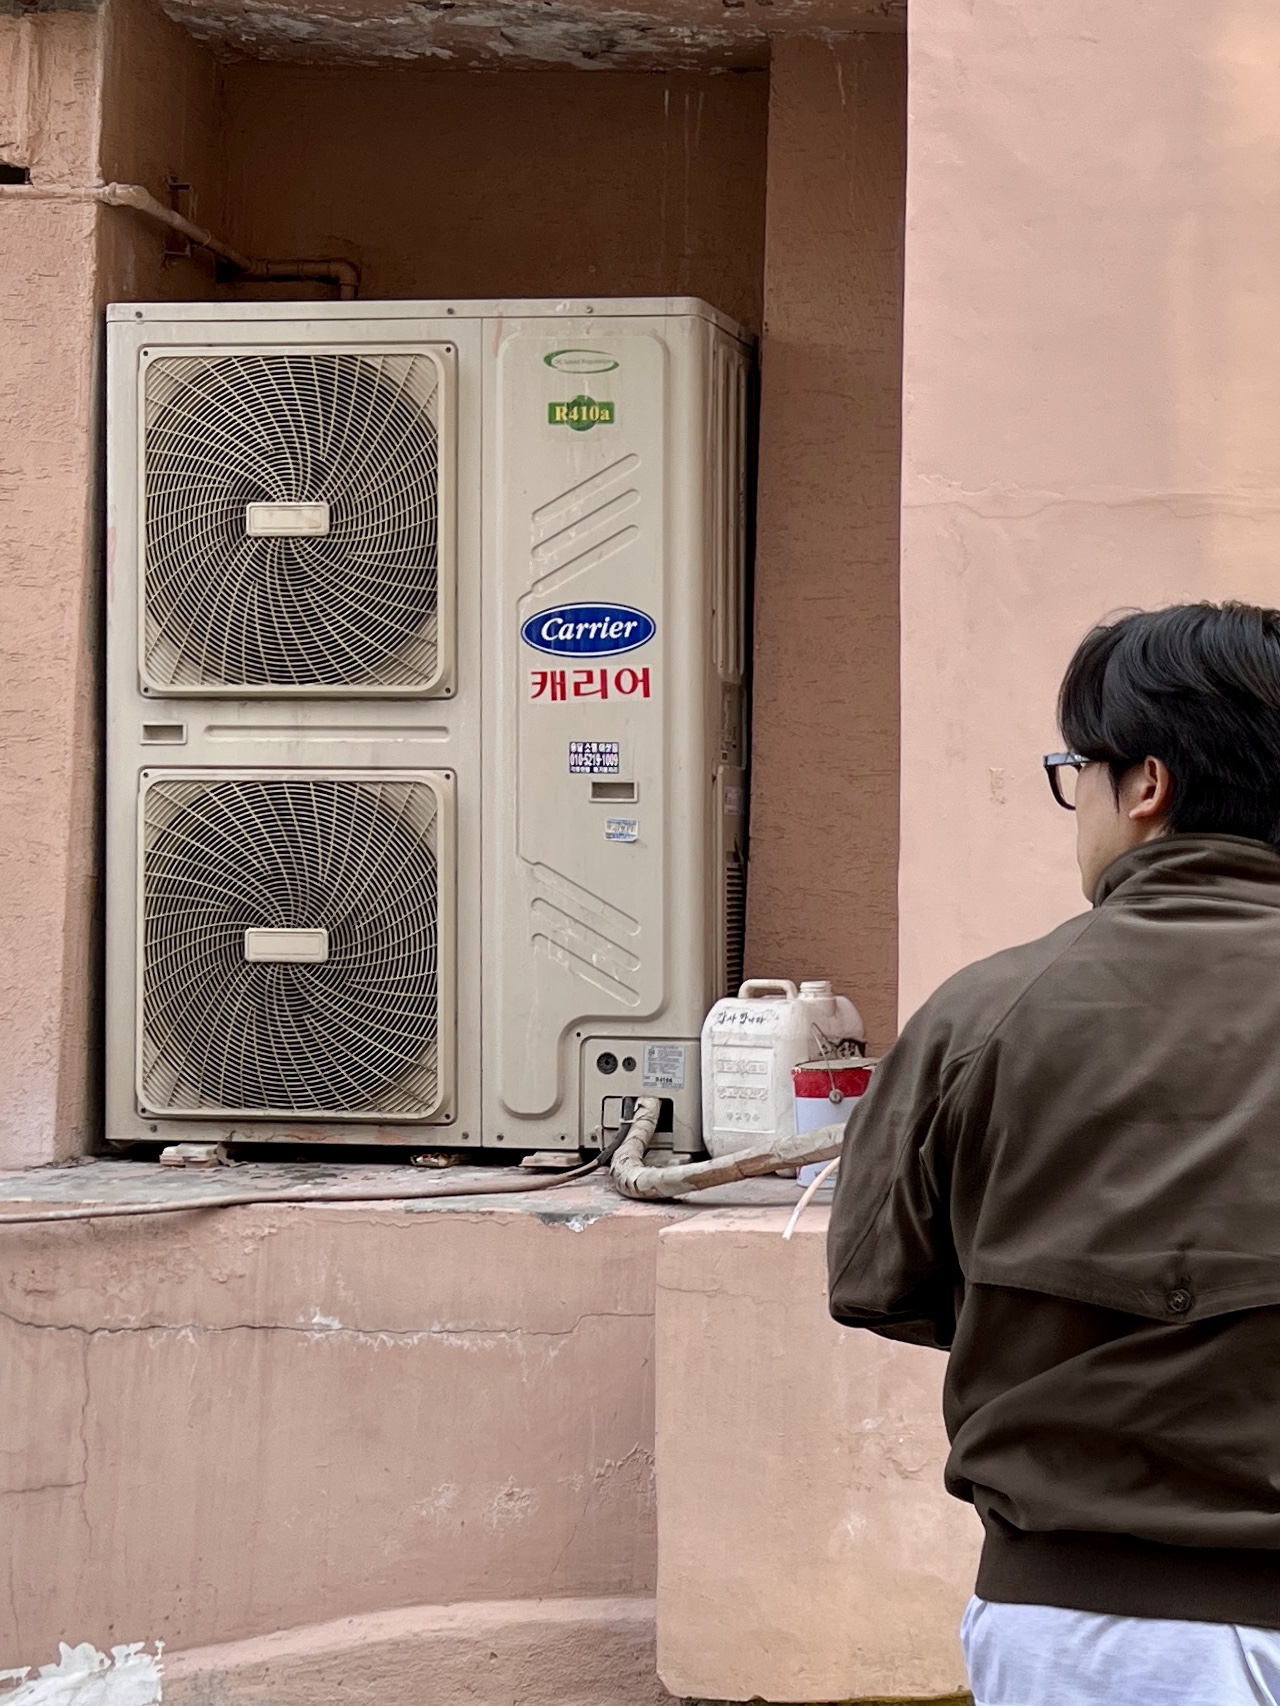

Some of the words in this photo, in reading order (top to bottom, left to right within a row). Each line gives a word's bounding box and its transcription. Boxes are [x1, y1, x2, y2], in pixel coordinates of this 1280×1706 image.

[555, 406, 610, 421] R410a
[541, 617, 638, 641] Carrier
[531, 667, 651, 701] 캐리어
